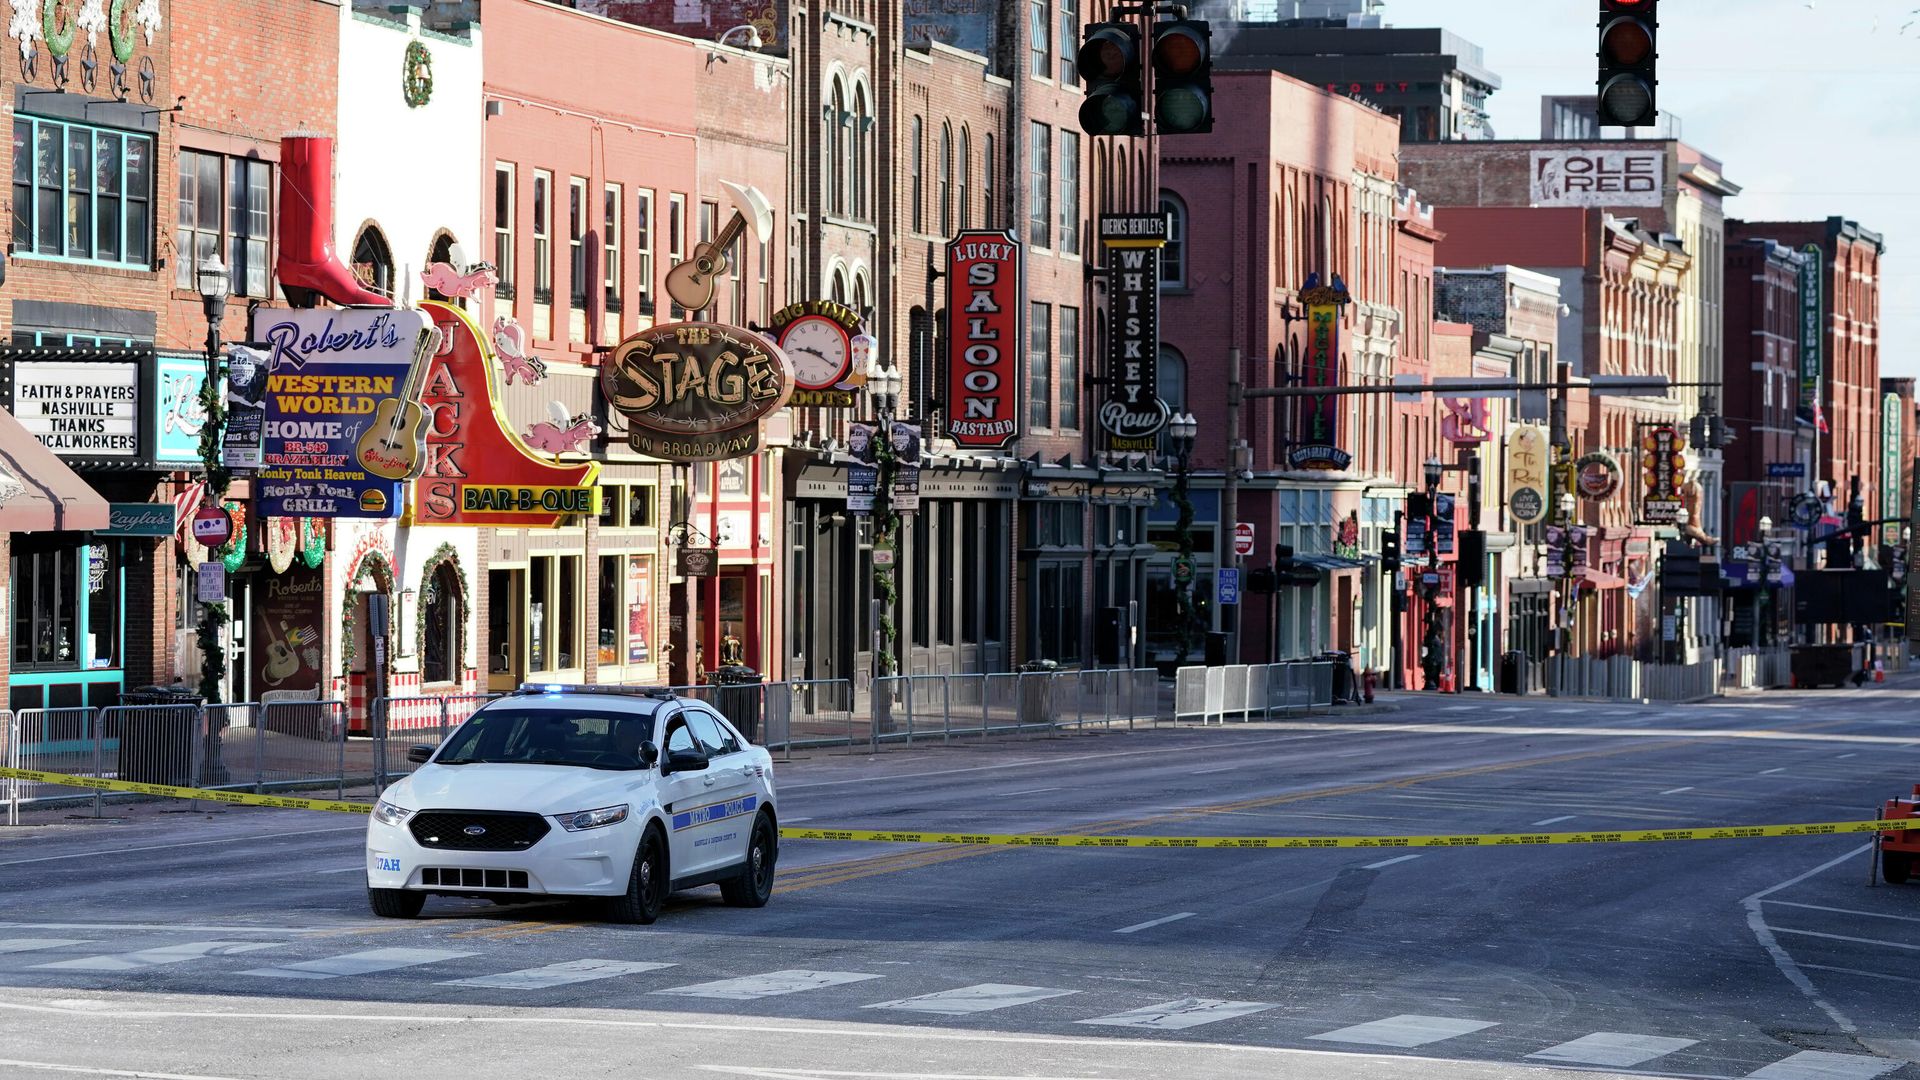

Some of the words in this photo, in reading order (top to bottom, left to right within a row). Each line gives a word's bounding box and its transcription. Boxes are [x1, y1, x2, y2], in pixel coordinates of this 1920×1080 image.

[911, 24, 952, 41] NEW
[1564, 156, 1655, 174] OLE
[1564, 175, 1655, 193] RED
[1102, 218, 1127, 235] DIERKS
[954, 242, 1014, 263] LUCKY
[772, 304, 806, 329] BIG
[811, 301, 861, 329] TIME
[1121, 251, 1145, 403] WHISKEY
[266, 312, 399, 373] Robert's
[676, 328, 711, 345] THE
[964, 263, 999, 419] SALOON
[266, 375, 394, 395] WESTERN
[613, 340, 779, 412] STAGE
[22, 385, 61, 399] FAITH
[65, 386, 73, 399] &
[76, 386, 135, 400] PRAYERS
[788, 391, 853, 407] OOTS
[41, 402, 114, 416] NASHVILLE
[276, 396, 377, 415] WORLD
[50, 418, 105, 433] THANKS
[419, 320, 468, 520] JACKS
[951, 419, 1014, 436] BASTARD
[1106, 402, 1159, 436] Row
[264, 421, 342, 439] HOME
[345, 421, 362, 444] of
[283, 441, 328, 454] BR-549
[631, 436, 653, 452] ON
[661, 435, 753, 457] BROADWAY
[1111, 437, 1154, 450] NASHVILLE
[294, 467, 322, 480] Tonk
[324, 468, 365, 481] Heaven
[1657, 433, 1672, 500] WHISKEY
[263, 483, 313, 498] Honky
[316, 482, 356, 500] Tonk
[282, 500, 338, 513] GRILL
[463, 488, 593, 513] BAR-B-QUE
[1515, 501, 1538, 509] MUSIC
[1647, 501, 1681, 510] BENT
[266, 576, 322, 598] Robert's
[689, 807, 711, 825] METRO
[724, 800, 744, 817] POLICE
